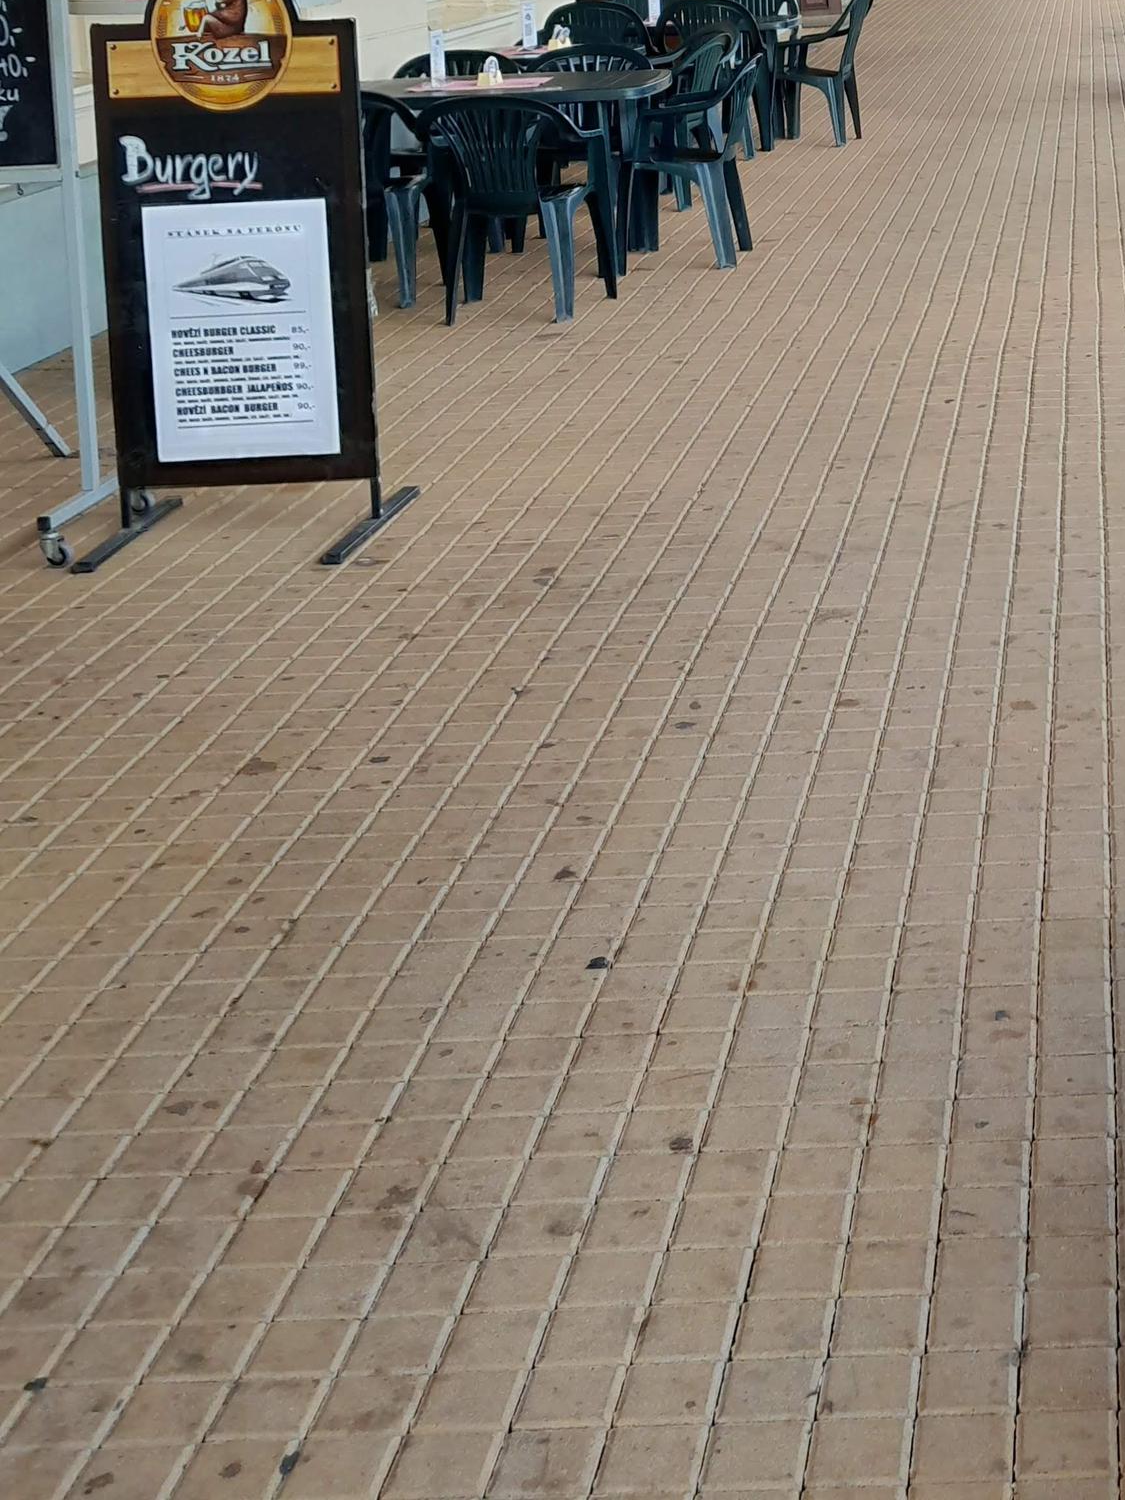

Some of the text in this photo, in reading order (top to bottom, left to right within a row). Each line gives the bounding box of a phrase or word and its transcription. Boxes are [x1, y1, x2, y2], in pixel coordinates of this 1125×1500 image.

[171, 40, 273, 71] Kozel
[210, 73, 240, 83] 1874
[118, 135, 259, 200] Burgery
[171, 327, 200, 338] HOVĚZÍ
[204, 327, 237, 337] BURGER
[240, 325, 276, 335] CLASSIC
[173, 346, 234, 358] CHEESBURGER
[174, 367, 200, 376] CHEES
[204, 366, 208, 375] N
[211, 365, 240, 375] BACON
[243, 363, 276, 373] BURGER
[247, 382, 293, 392] JALAPEÑOS
[177, 405, 206, 415] HOVĚZÍ
[211, 404, 240, 414] BACON
[245, 402, 278, 412] BURGER
